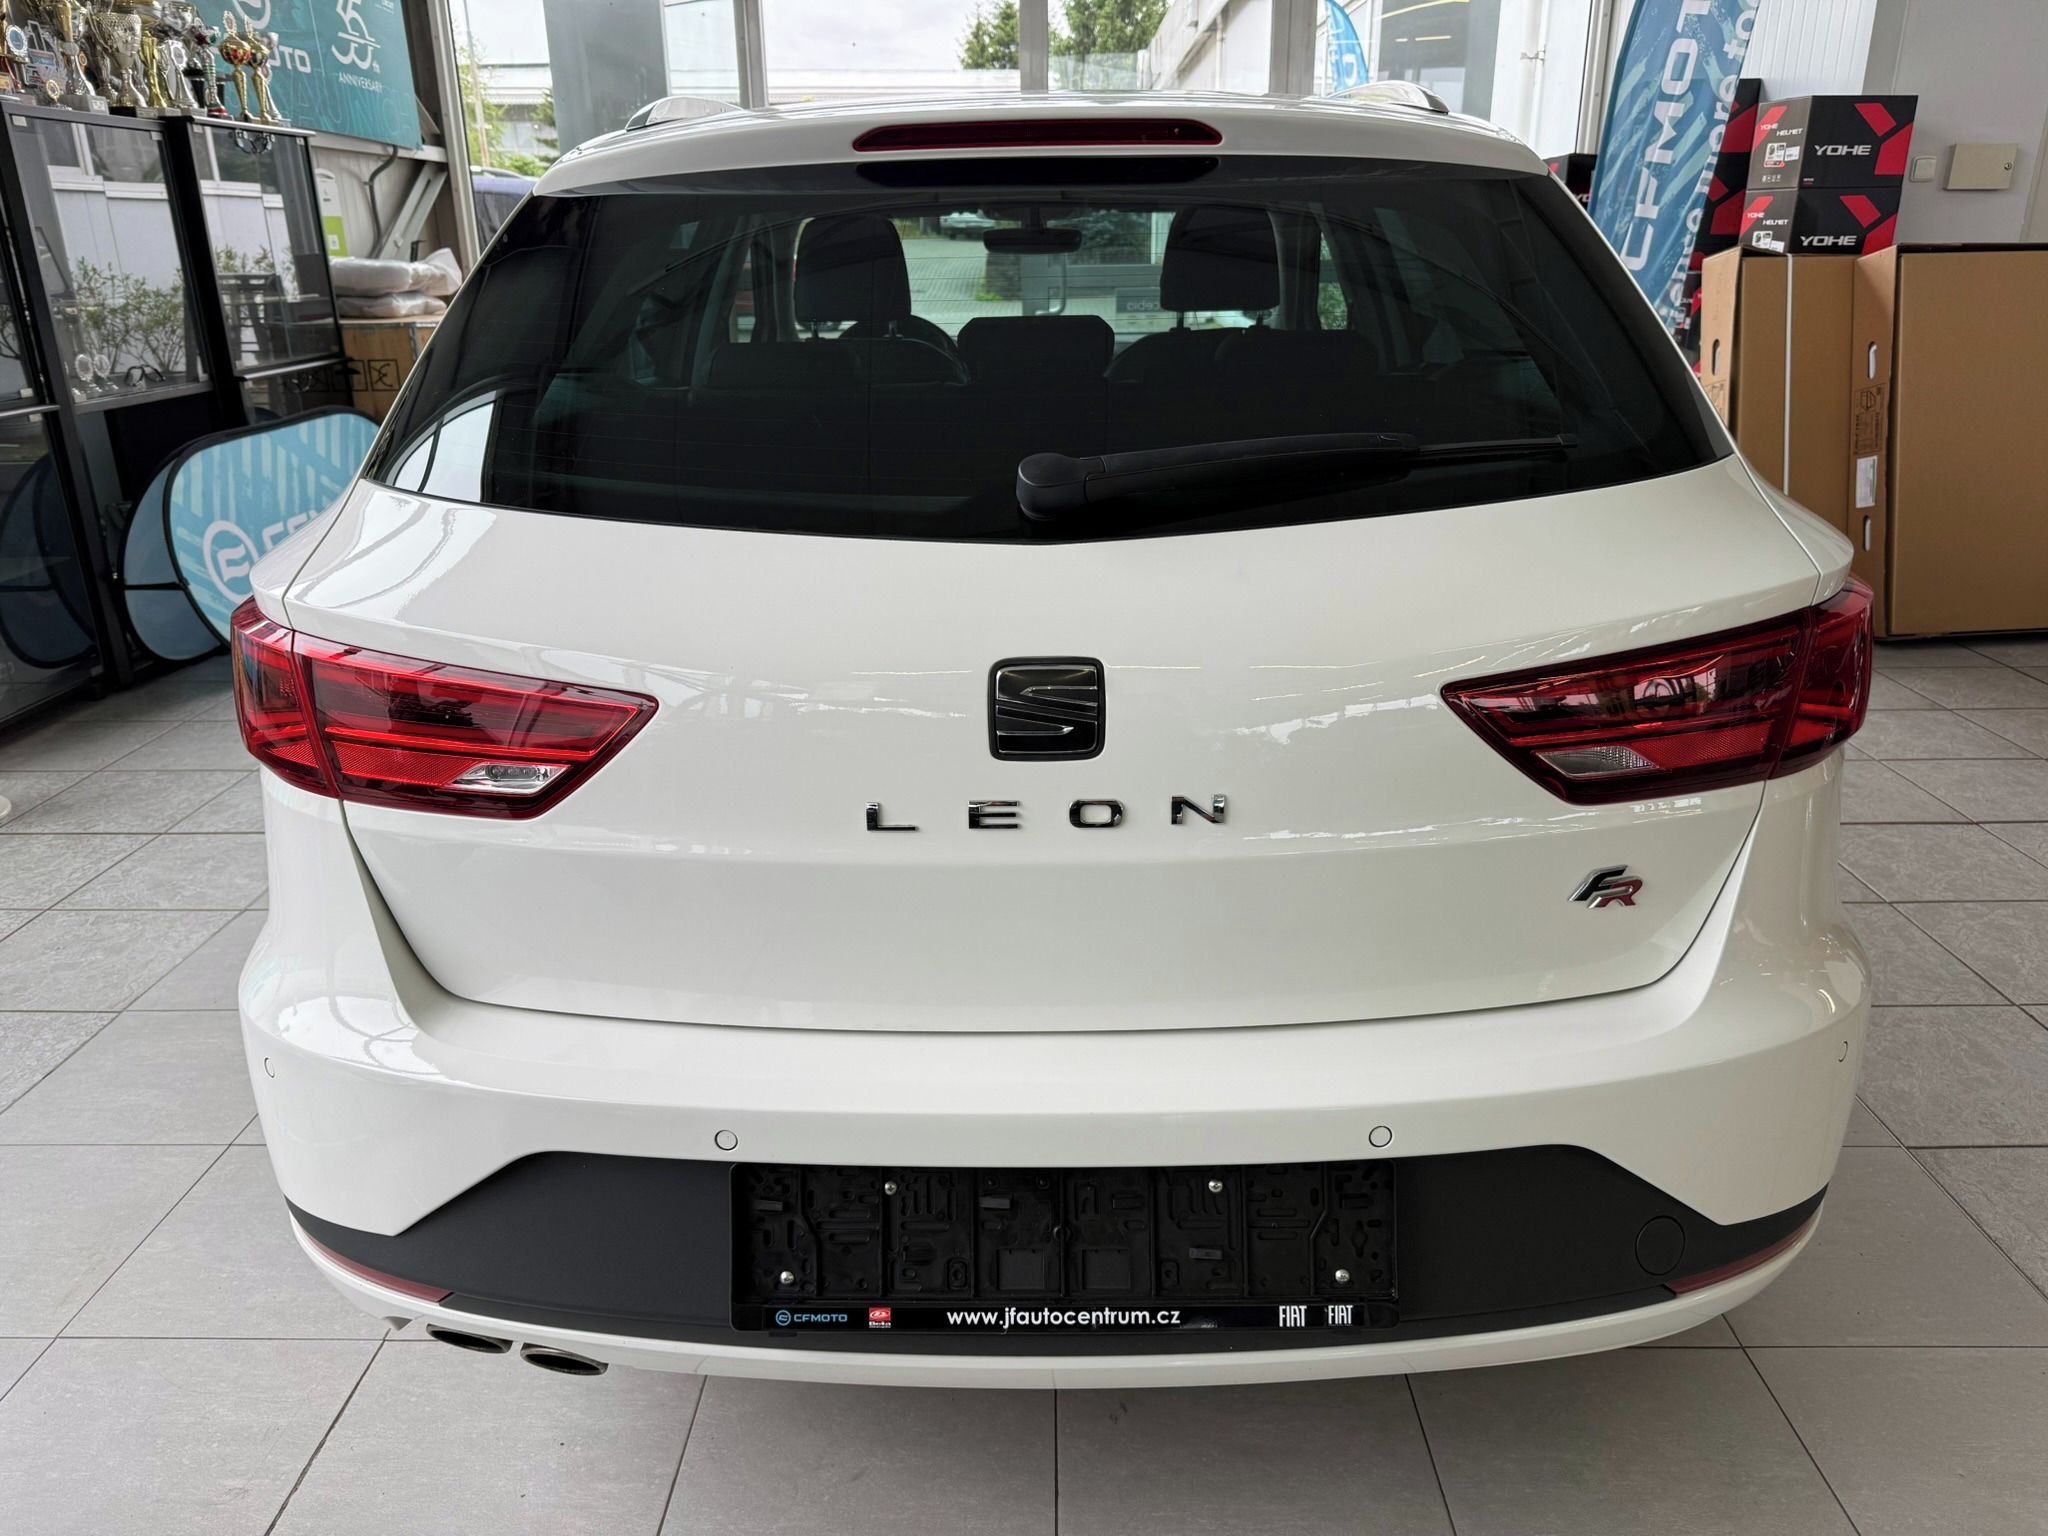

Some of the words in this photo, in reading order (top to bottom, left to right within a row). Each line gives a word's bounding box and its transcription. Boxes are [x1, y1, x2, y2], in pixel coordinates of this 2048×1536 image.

[338, 72, 384, 93] ANNIVERSARY
[1760, 122, 1779, 132] YOHE
[1776, 127, 1803, 137] HELMET
[1813, 144, 1873, 157] YOHE
[1762, 218, 1789, 226] HELMET
[1800, 235, 1858, 247] YOHE
[865, 793, 1228, 833] LEON
[1567, 864, 1644, 909] FR
[793, 1313, 849, 1323] CFMOTO
[946, 1306, 1182, 1329] www.jfautocentrum.cz
[1278, 1305, 1308, 1328] FIAT
[1327, 1304, 1354, 1325] FIAT
